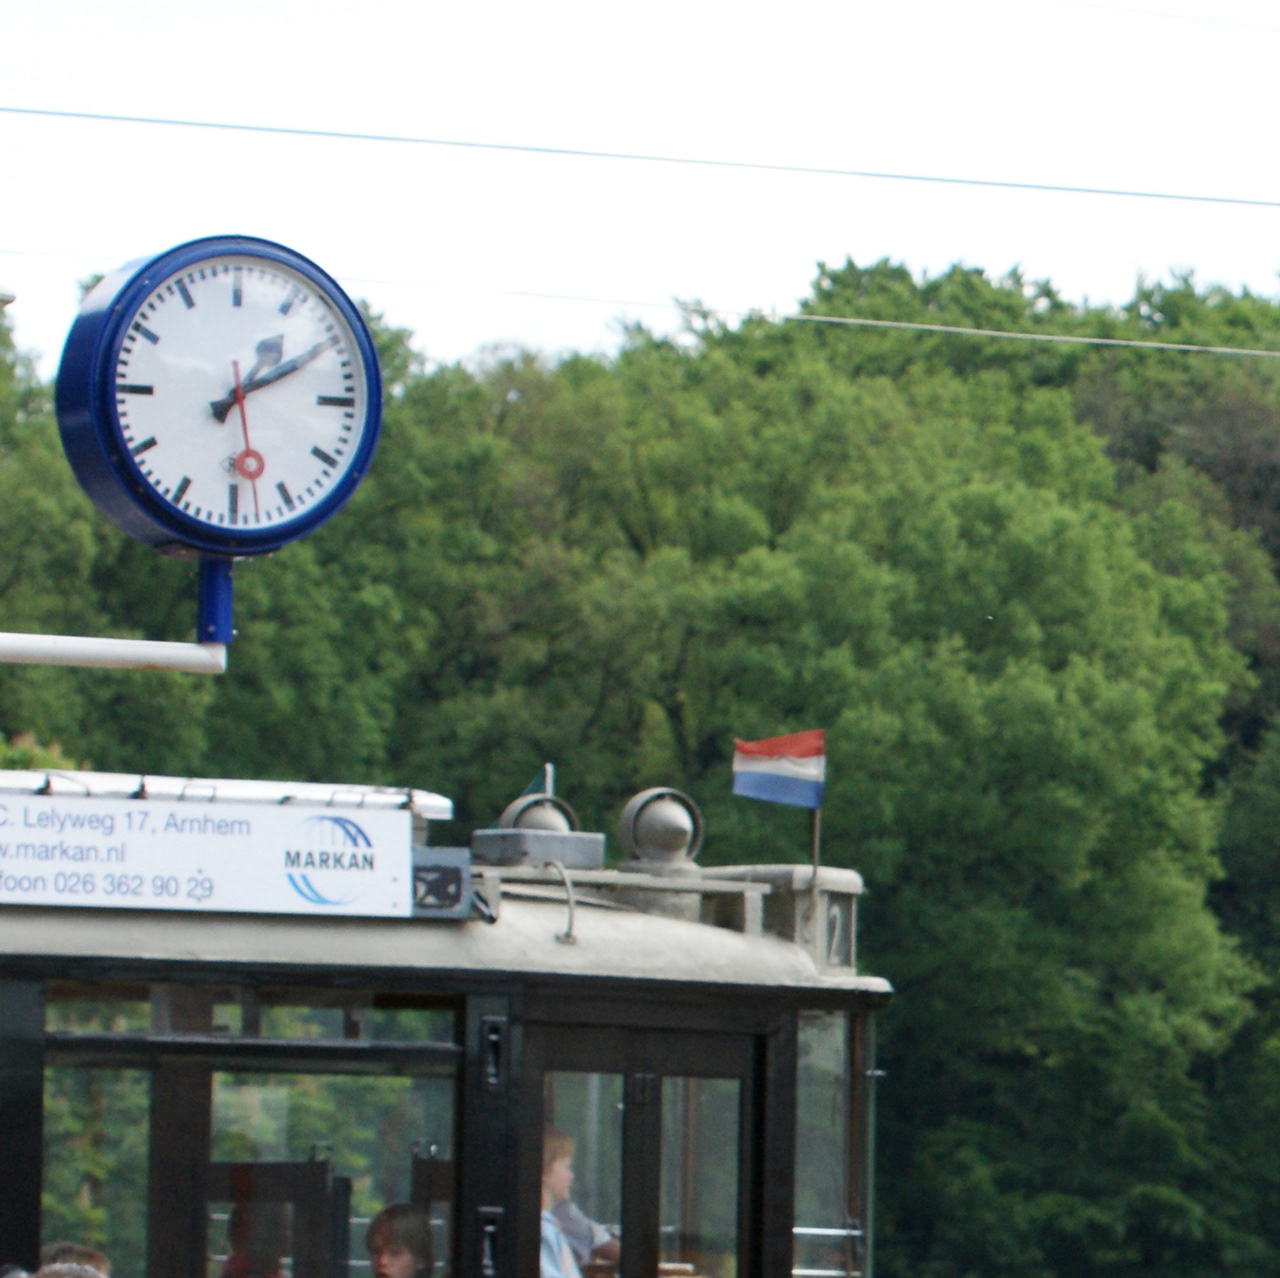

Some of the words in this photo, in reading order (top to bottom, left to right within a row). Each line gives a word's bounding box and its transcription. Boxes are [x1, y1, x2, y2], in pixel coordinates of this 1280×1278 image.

[23, 805, 115, 836] Lelyweg
[124, 810, 156, 835] 17,
[163, 811, 251, 836] Arnhem
[284, 850, 374, 871] MARKAN
[54, 871, 95, 894] 026
[103, 873, 143, 896] 362
[151, 875, 179, 898] 90
[186, 876, 213, 899] 29
